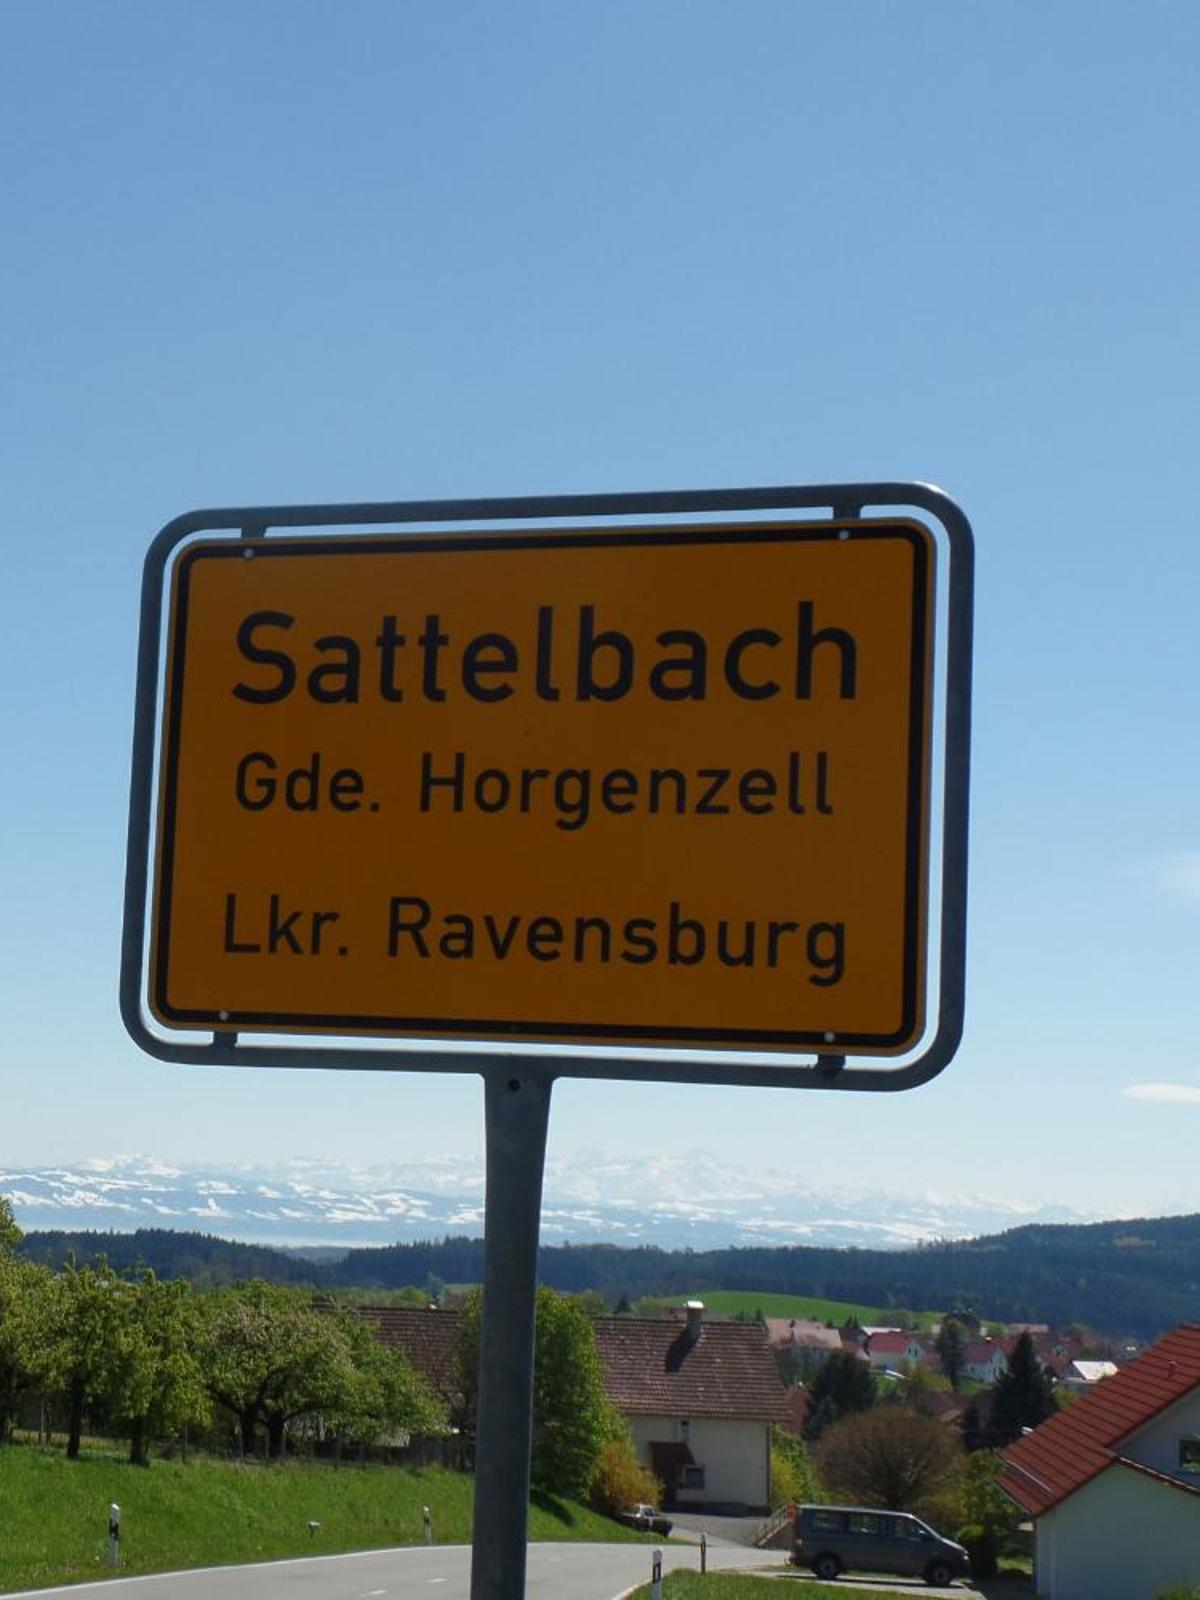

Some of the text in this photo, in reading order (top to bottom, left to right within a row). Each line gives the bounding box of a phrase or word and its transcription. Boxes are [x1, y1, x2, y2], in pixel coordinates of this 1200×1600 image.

[231, 600, 858, 705] Sattelbach
[235, 751, 834, 832] Gde. Horgenzell
[223, 893, 846, 988] Lkr. Ravensburg
